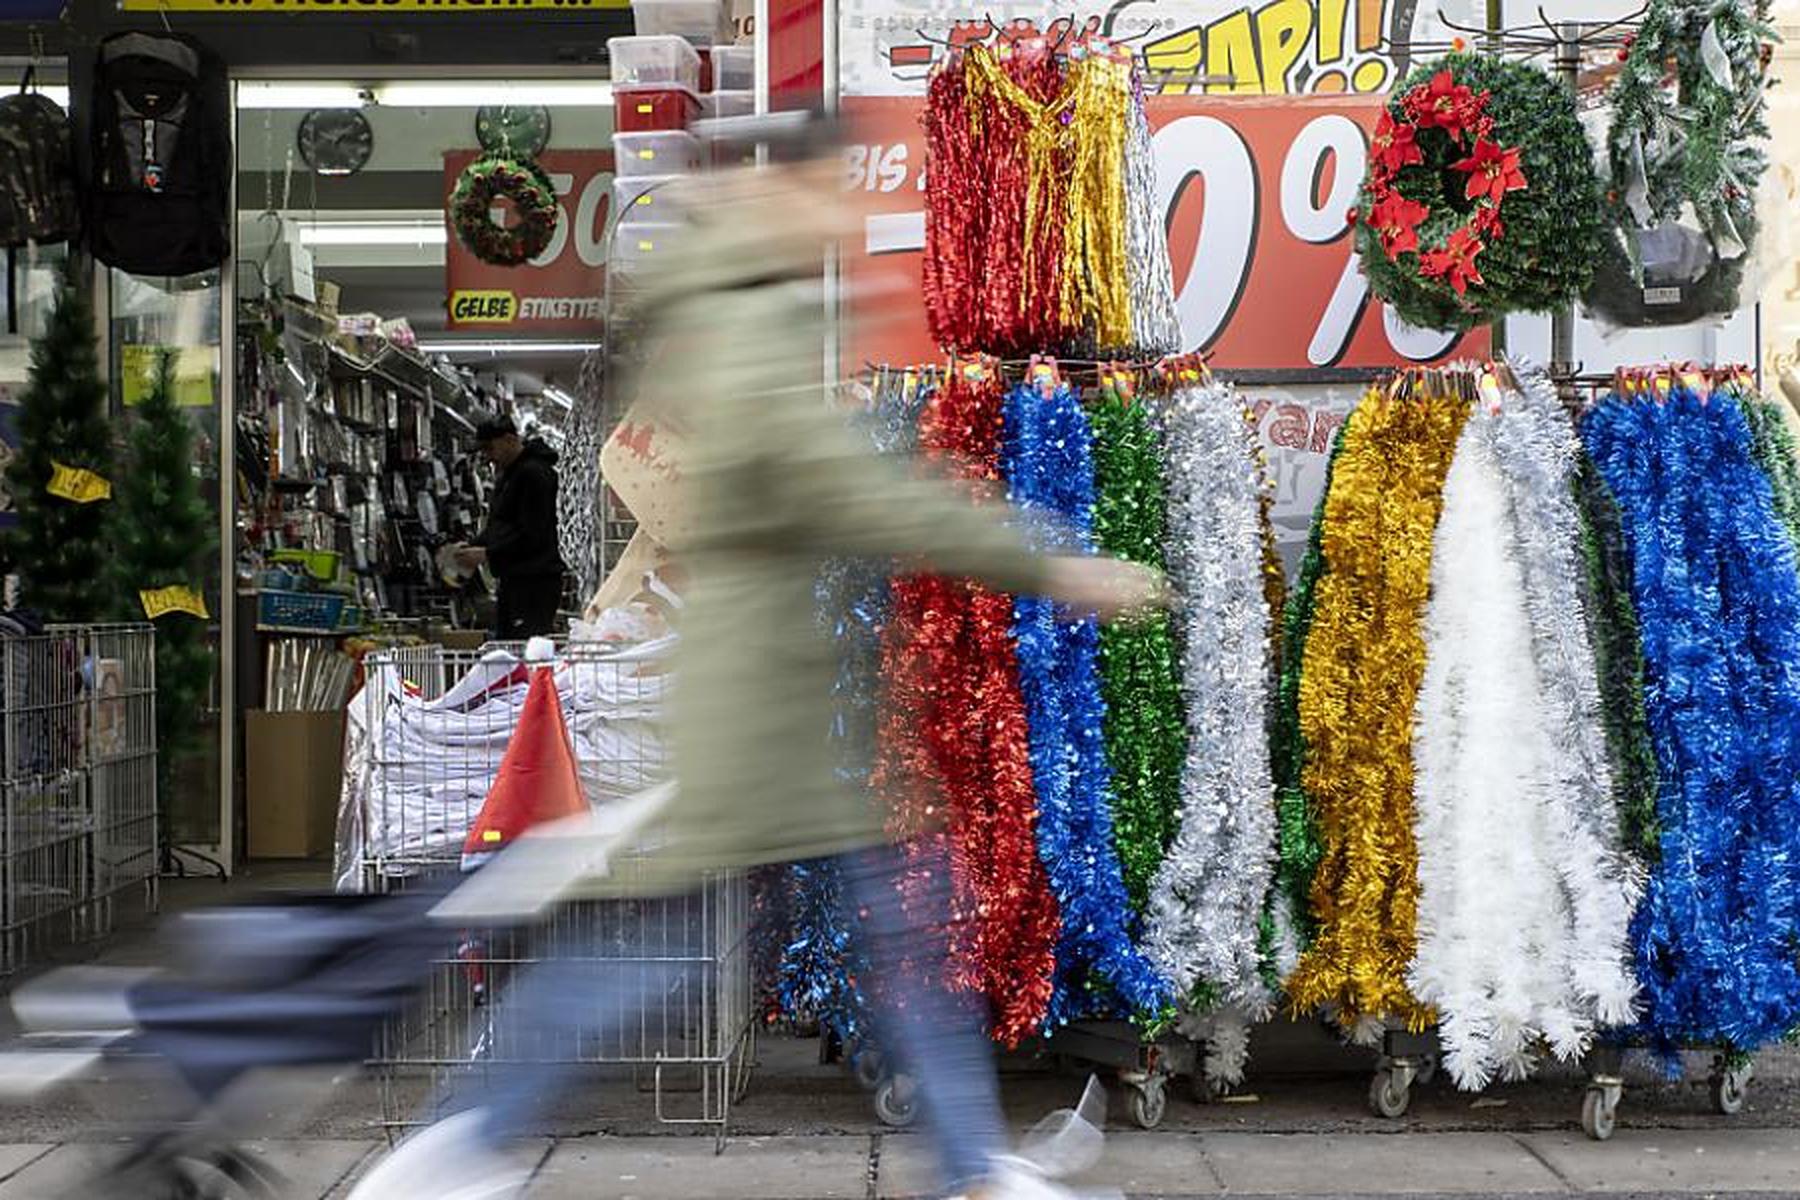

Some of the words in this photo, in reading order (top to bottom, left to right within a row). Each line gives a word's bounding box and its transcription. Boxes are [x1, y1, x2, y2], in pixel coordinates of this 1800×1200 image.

[841, 143, 907, 192] BIS
[454, 296, 511, 319] GELBE
[518, 297, 606, 319] ETIKETTE
